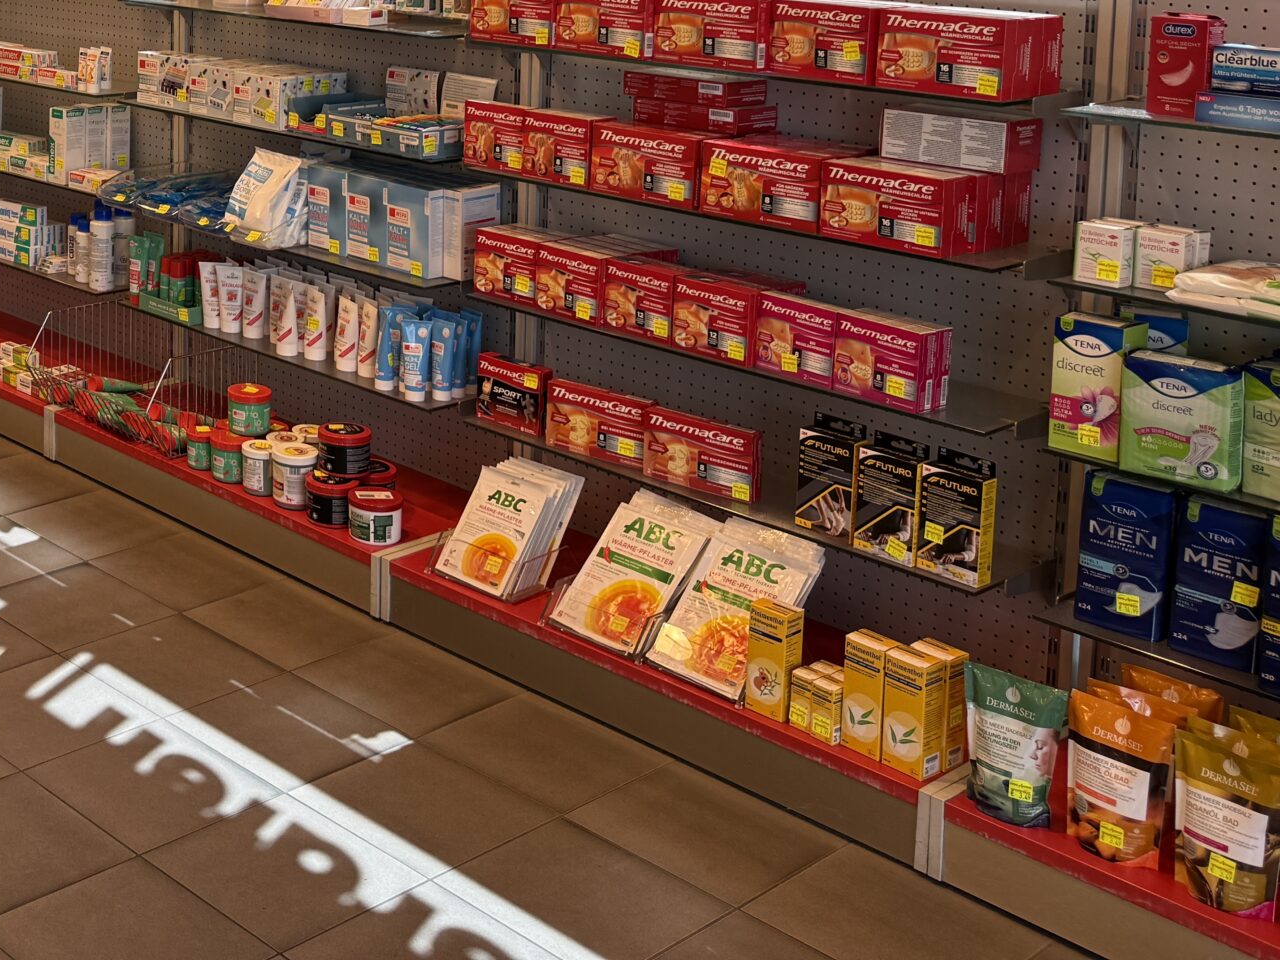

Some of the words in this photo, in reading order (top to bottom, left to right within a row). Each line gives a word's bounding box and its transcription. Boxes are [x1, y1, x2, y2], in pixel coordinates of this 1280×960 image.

[776, 3, 864, 24] ThermaCare
[886, 14, 1000, 36] ThermaCare
[1165, 24, 1193, 35] durex
[939, 64, 949, 72] 16
[1215, 51, 1278, 68] Clearblue
[39, 69, 55, 78] elmex
[1231, 71, 1257, 79] Frühtest
[466, 106, 523, 123] ThermaCare
[1246, 105, 1267, 116] Tage
[524, 117, 587, 135] ThermaCare
[600, 129, 687, 153] ThermaCare
[712, 147, 811, 172] ThermaCare
[828, 167, 938, 194] ThermaCare
[477, 235, 535, 256] ThermaCare
[1080, 236, 1118, 247] PUTZTÜCHER
[1139, 242, 1180, 254] PUTZTÜCHER
[539, 249, 598, 272] ThermaCare
[607, 265, 669, 289] ThermaCare
[676, 283, 747, 308] ThermaCare
[761, 300, 834, 326] ThermaCare
[839, 320, 919, 349] ThermaCare
[1073, 338, 1102, 351] TENA
[404, 362, 419, 371] GEL
[1056, 356, 1106, 378] discreet
[493, 385, 522, 400] SPORT
[1158, 380, 1187, 393] TENA
[552, 386, 643, 416] ThermaCare
[1152, 399, 1194, 416] discreet
[1053, 408, 1072, 416] ULTRA
[1252, 405, 1280, 427] lady
[649, 413, 745, 446] ThermaCare
[815, 441, 849, 457] FUTURO
[875, 461, 912, 477] FUTURO
[939, 478, 978, 496] FUTURO
[488, 490, 527, 512] ABC
[1110, 505, 1137, 518] TENA
[624, 517, 684, 551] ABC
[1089, 519, 1157, 550] MEN
[1208, 532, 1235, 545] TENA
[612, 538, 674, 566] WÄRME-PFLASTER
[721, 548, 786, 585] ABC
[1184, 548, 1258, 581] MEN
[1078, 603, 1091, 611] x24
[750, 608, 785, 626] Pinimenthol
[1173, 631, 1187, 640] x24
[846, 642, 882, 661] Pinimenthol
[887, 658, 923, 678] Pinimenthol
[986, 696, 1035, 721] DERMASEL
[989, 721, 1005, 731] MEER
[1005, 725, 1033, 740] BADESALZ
[1092, 726, 1143, 753] DERMASEL
[1009, 738, 1021, 747] DER
[1093, 755, 1108, 766] MEER
[1109, 761, 1138, 777] BADESALZ
[1104, 769, 1129, 784] ÖLBAD
[1201, 767, 1259, 797] DERMASEL
[1203, 795, 1220, 807] MEER
[1222, 801, 1252, 819] BADESALZ
[1222, 814, 1239, 827] BAD
